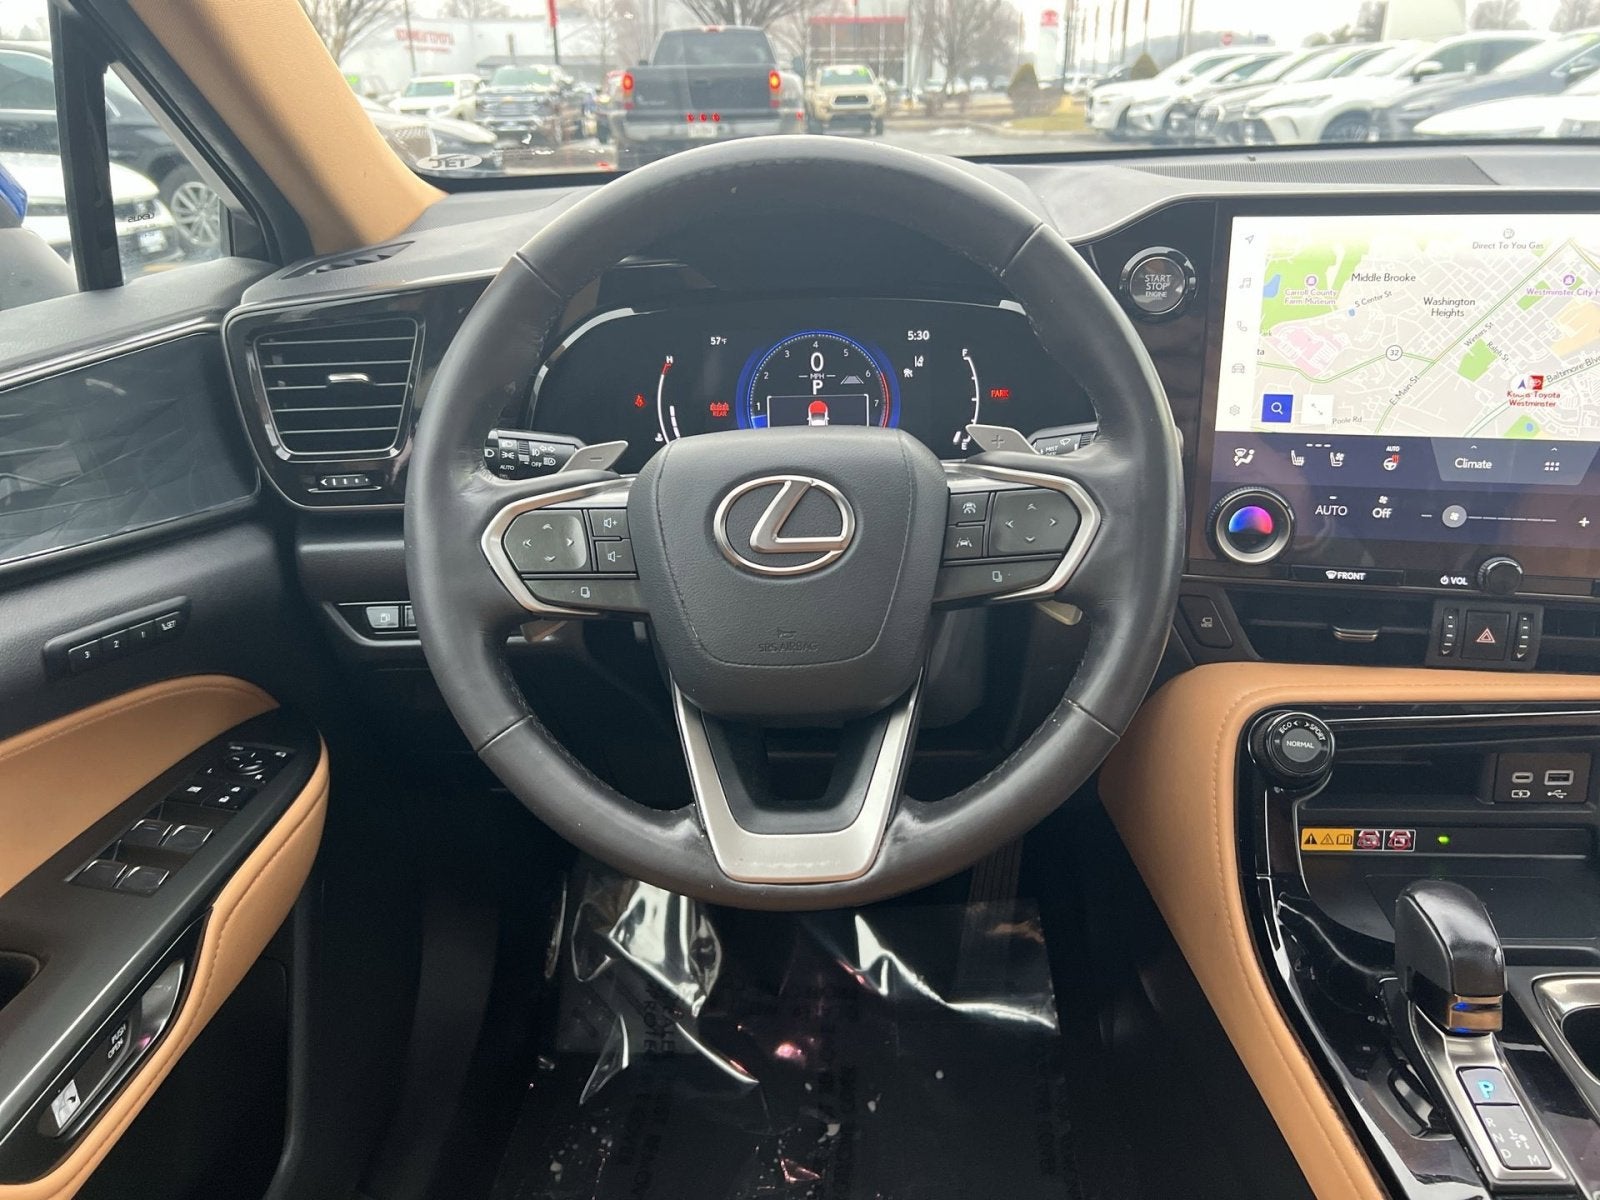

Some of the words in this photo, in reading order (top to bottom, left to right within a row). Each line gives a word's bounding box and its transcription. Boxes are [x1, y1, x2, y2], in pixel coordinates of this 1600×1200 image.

[429, 155, 470, 169] JET
[1472, 242, 1495, 250] Direct
[1499, 242, 1509, 250] To
[1512, 242, 1526, 250] You
[1528, 242, 1544, 250] Gas
[1145, 274, 1172, 282] START
[1351, 273, 1381, 282] Middle
[1384, 273, 1416, 282] Brooke
[1145, 283, 1168, 291] STOP
[1526, 287, 1574, 296] Westminster
[1576, 288, 1593, 297] City
[1361, 294, 1383, 306] Center
[1384, 290, 1393, 299] St
[1423, 297, 1476, 307] Washington
[1431, 308, 1465, 319] Heights
[907, 330, 930, 341] 5:30
[784, 350, 790, 358] 3
[843, 349, 849, 357] 5
[961, 348, 968, 357] F
[666, 355, 674, 363] H
[763, 372, 769, 380] 2
[1546, 363, 1586, 383] Baltimore
[812, 380, 823, 395] P
[1394, 381, 1413, 399] Main
[990, 389, 1009, 398] PARK
[1534, 391, 1561, 400] Toyota
[874, 399, 879, 407] 7
[1508, 399, 1557, 408] Westminster
[1352, 415, 1363, 423] Rd
[961, 442, 967, 450] E
[1454, 457, 1493, 470] Climate
[1315, 505, 1348, 517] AUTO
[1372, 507, 1392, 519] Off
[1337, 571, 1366, 581] FRONT
[1450, 576, 1468, 586] VOL
[113, 640, 119, 649] 2
[84, 650, 90, 659] 3
[1278, 721, 1293, 734] ECO
[1309, 723, 1326, 741] SPORT
[1286, 740, 1315, 749] NORMAL
[107, 1037, 124, 1059] OPEN
[1477, 1080, 1495, 1099] P
[1485, 1117, 1496, 1128] R
[1492, 1132, 1505, 1144] N
[1500, 1148, 1512, 1159] D
[1527, 1154, 1542, 1166] M
